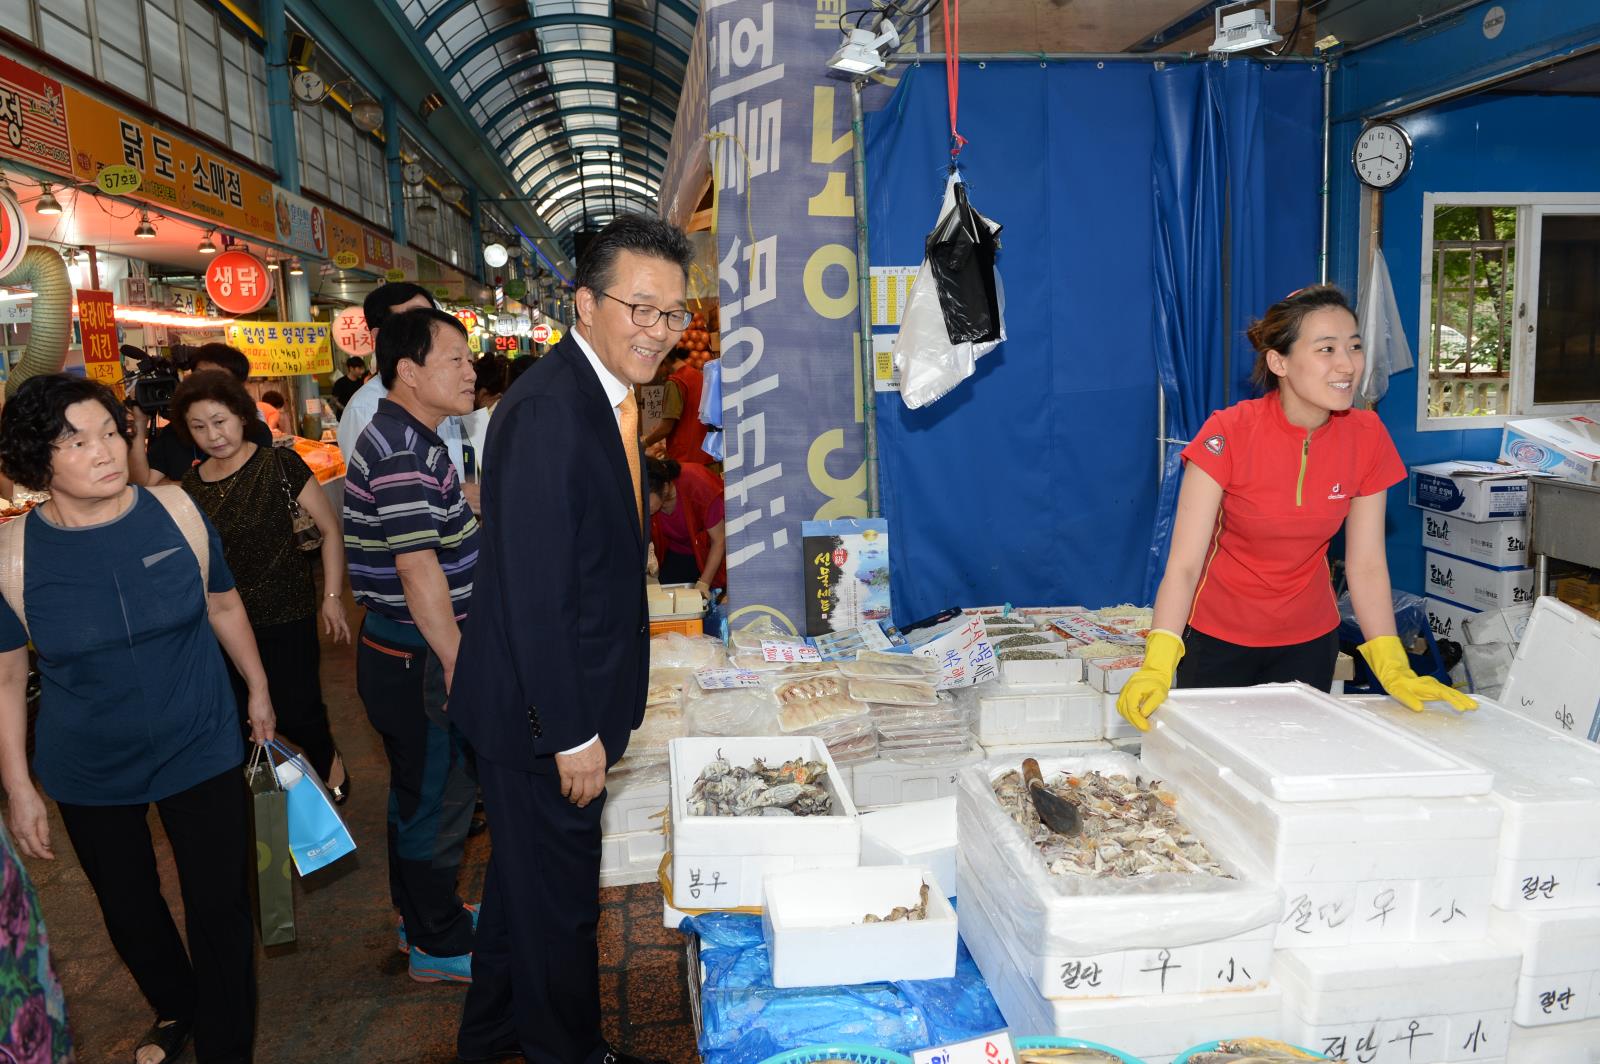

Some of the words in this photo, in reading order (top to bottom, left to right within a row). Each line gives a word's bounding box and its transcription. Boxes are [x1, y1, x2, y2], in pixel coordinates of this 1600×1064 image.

[119, 118, 146, 172] 닭
[1378, 132, 1385, 140] 12
[213, 266, 259, 298] 생닭
[90, 334, 112, 359] 치킨
[1060, 961, 1103, 990] 절단
